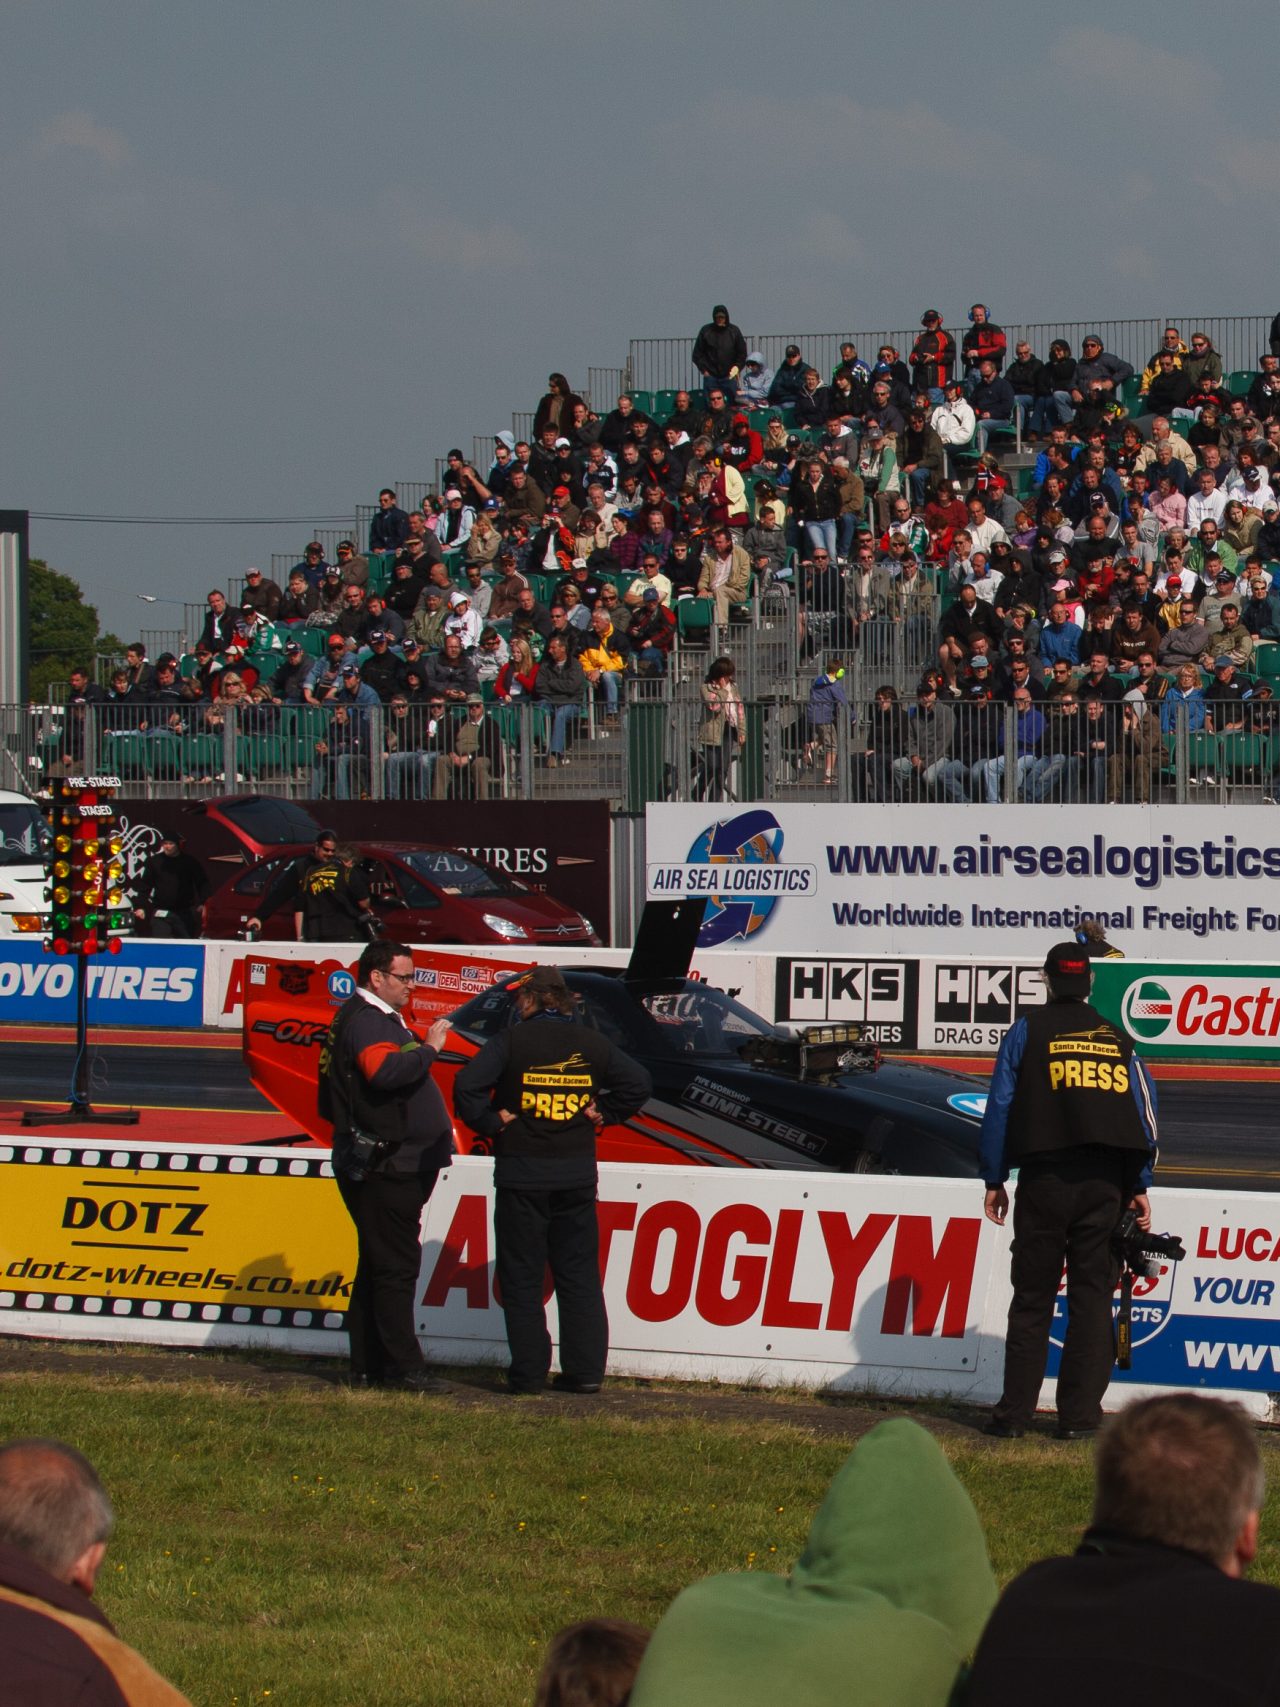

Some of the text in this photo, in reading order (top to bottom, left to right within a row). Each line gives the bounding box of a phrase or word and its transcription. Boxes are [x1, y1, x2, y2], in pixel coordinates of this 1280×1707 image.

[68, 777, 122, 787] PRE-STAGED
[79, 805, 113, 816] STAGED
[653, 869, 811, 891] AIR SEA LOGISTICS
[832, 902, 963, 929] Worldwide
[971, 905, 1134, 932] International
[1143, 907, 1237, 936] Freight
[87, 965, 197, 1002] TIRES
[416, 970, 436, 983] V8
[440, 976, 458, 988] DEFA
[794, 967, 900, 1002] HKS
[938, 969, 1048, 1005] HKS
[934, 1027, 984, 1045] DRAG
[1053, 1043, 1075, 1051] Santa
[1076, 1043, 1091, 1051] Pod
[526, 1075, 547, 1084] Santa
[1050, 1060, 1129, 1093] PRESS
[709, 1082, 751, 1103] WORKSHOP
[689, 1086, 810, 1147] TOMI-STEEL
[61, 1196, 209, 1237] DOTZ
[421, 1194, 982, 1340] ATOGLYM
[1193, 1277, 1273, 1305] YOUR
